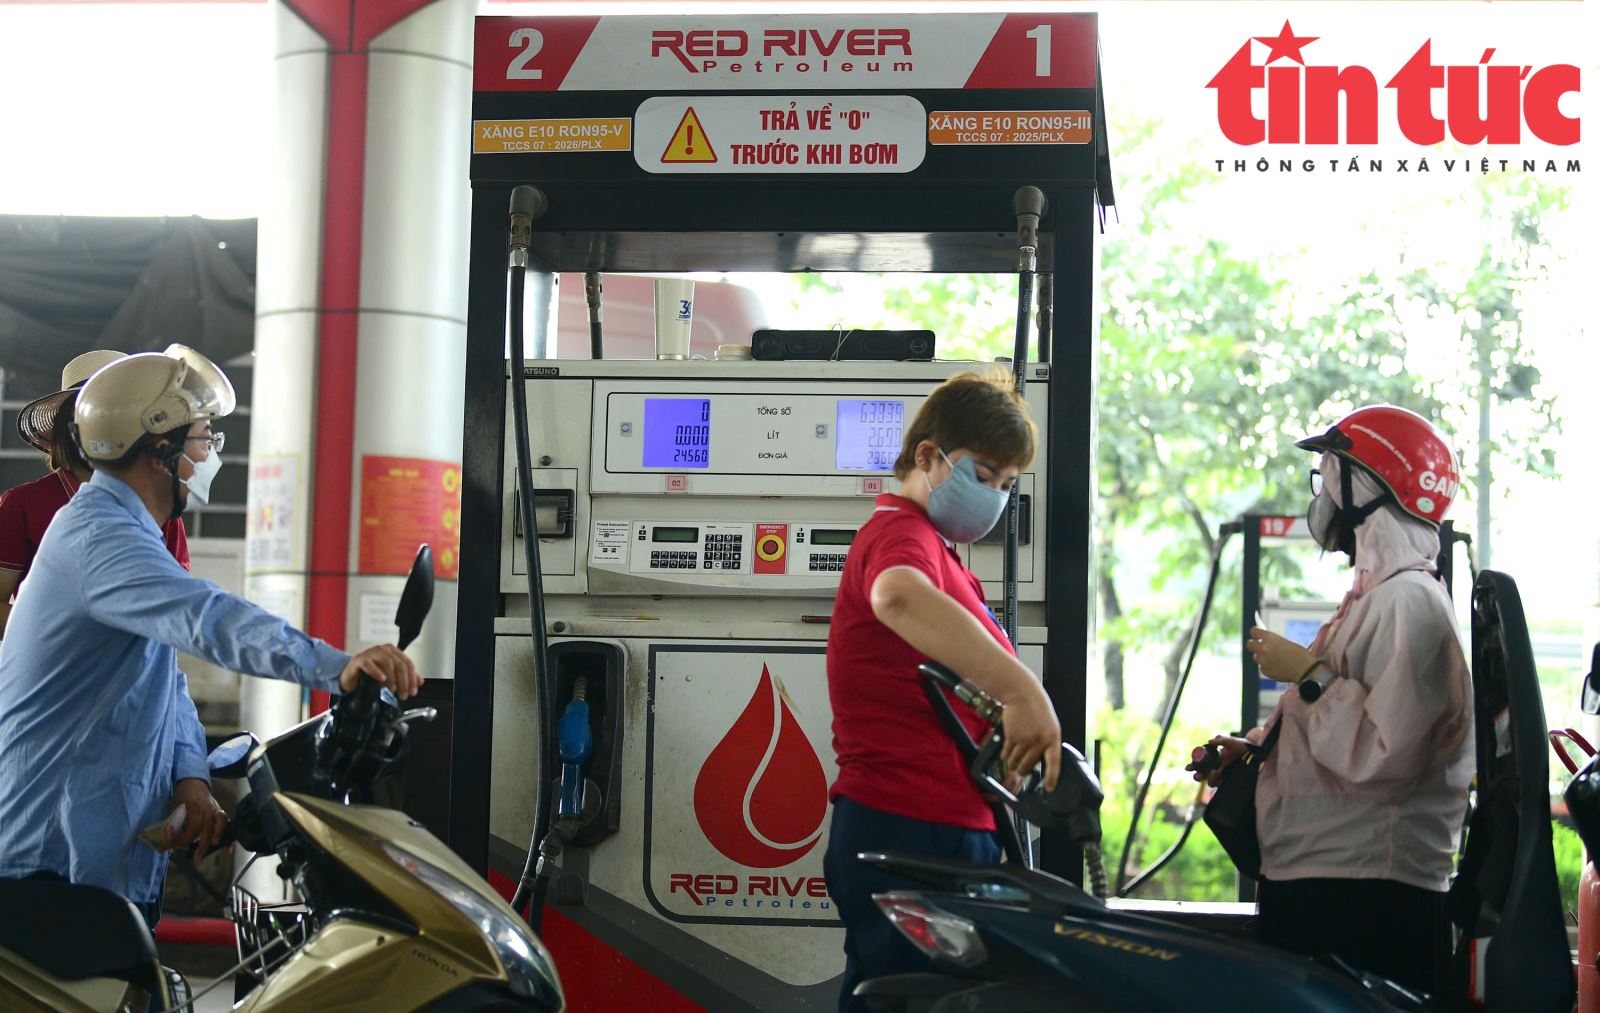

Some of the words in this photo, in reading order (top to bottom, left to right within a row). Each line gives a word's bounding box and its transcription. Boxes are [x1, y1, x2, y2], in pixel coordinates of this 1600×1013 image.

[506, 28, 544, 80] 2
[651, 30, 749, 73] RED
[763, 29, 912, 57] RIVER
[1026, 24, 1052, 77] 1
[703, 60, 913, 73] Petroleum
[760, 101, 800, 131] TRẢ
[806, 102, 833, 131] VỀ
[929, 115, 977, 131] XĂNG
[982, 117, 1012, 130] E10
[1016, 116, 1092, 130] RON95-III
[482, 125, 524, 139] XĂNG
[528, 126, 555, 138] E10
[559, 124, 623, 137] RON95-V
[955, 132, 987, 142] TCCS
[990, 132, 1003, 142] 07
[1013, 132, 1064, 142] 2025/PLX
[502, 141, 530, 151] TCCS
[533, 141, 545, 150] 07
[554, 140, 603, 150] 2026/PLX
[730, 138, 799, 165] TRƯỚC
[806, 144, 842, 165] KHI
[849, 142, 898, 165] BƠM
[524, 367, 558, 375] ATSUNO
[702, 401, 710, 422] 0
[675, 425, 709, 446] 0.000
[767, 429, 780, 440] LÍT
[674, 449, 708, 462] 24560
[671, 479, 681, 487] 02
[868, 482, 877, 490] 01
[670, 873, 738, 906] RED
[748, 876, 832, 897] RIVE
[706, 896, 830, 909] Petroleu
